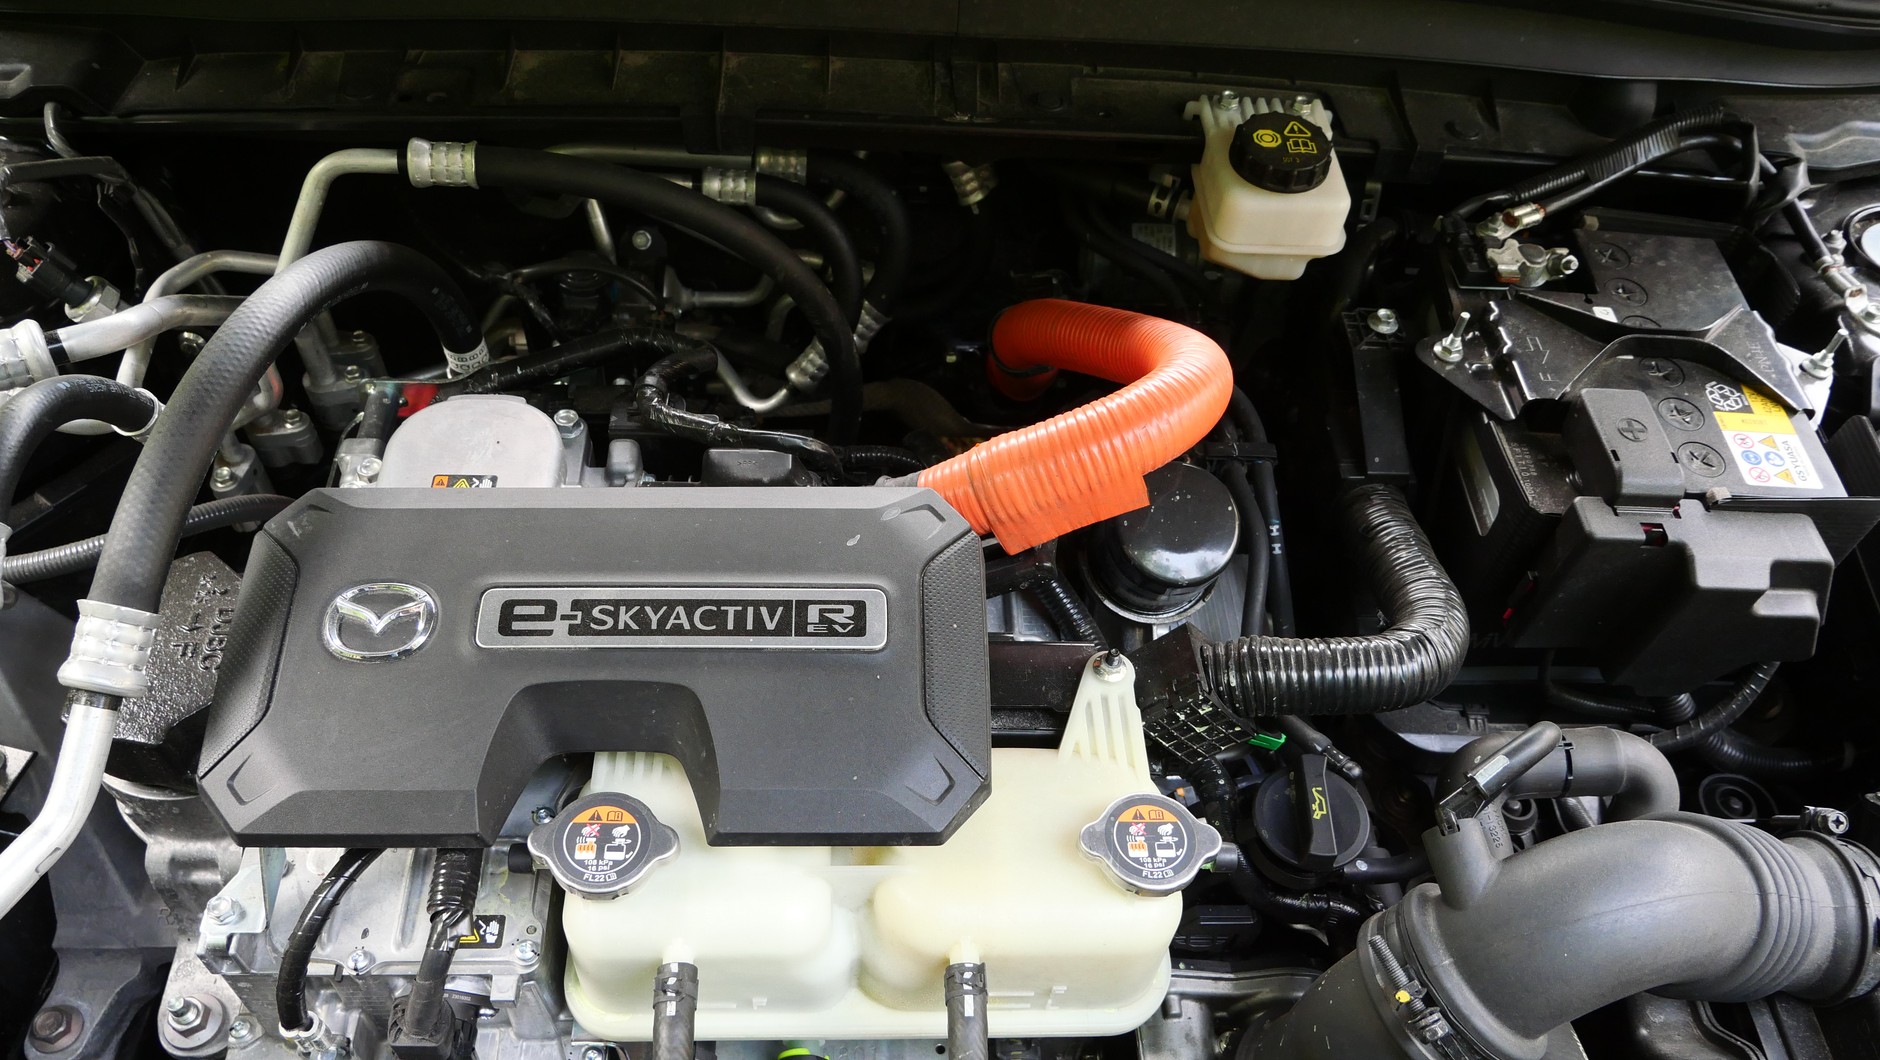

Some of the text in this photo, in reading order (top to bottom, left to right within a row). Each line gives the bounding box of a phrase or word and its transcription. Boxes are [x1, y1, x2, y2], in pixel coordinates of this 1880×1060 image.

[1781, 440, 1800, 469] YUASA
[1796, 470, 1808, 482] GS
[806, 623, 856, 633] EV
[583, 873, 605, 882] FL22
[1142, 870, 1164, 879] FL22
